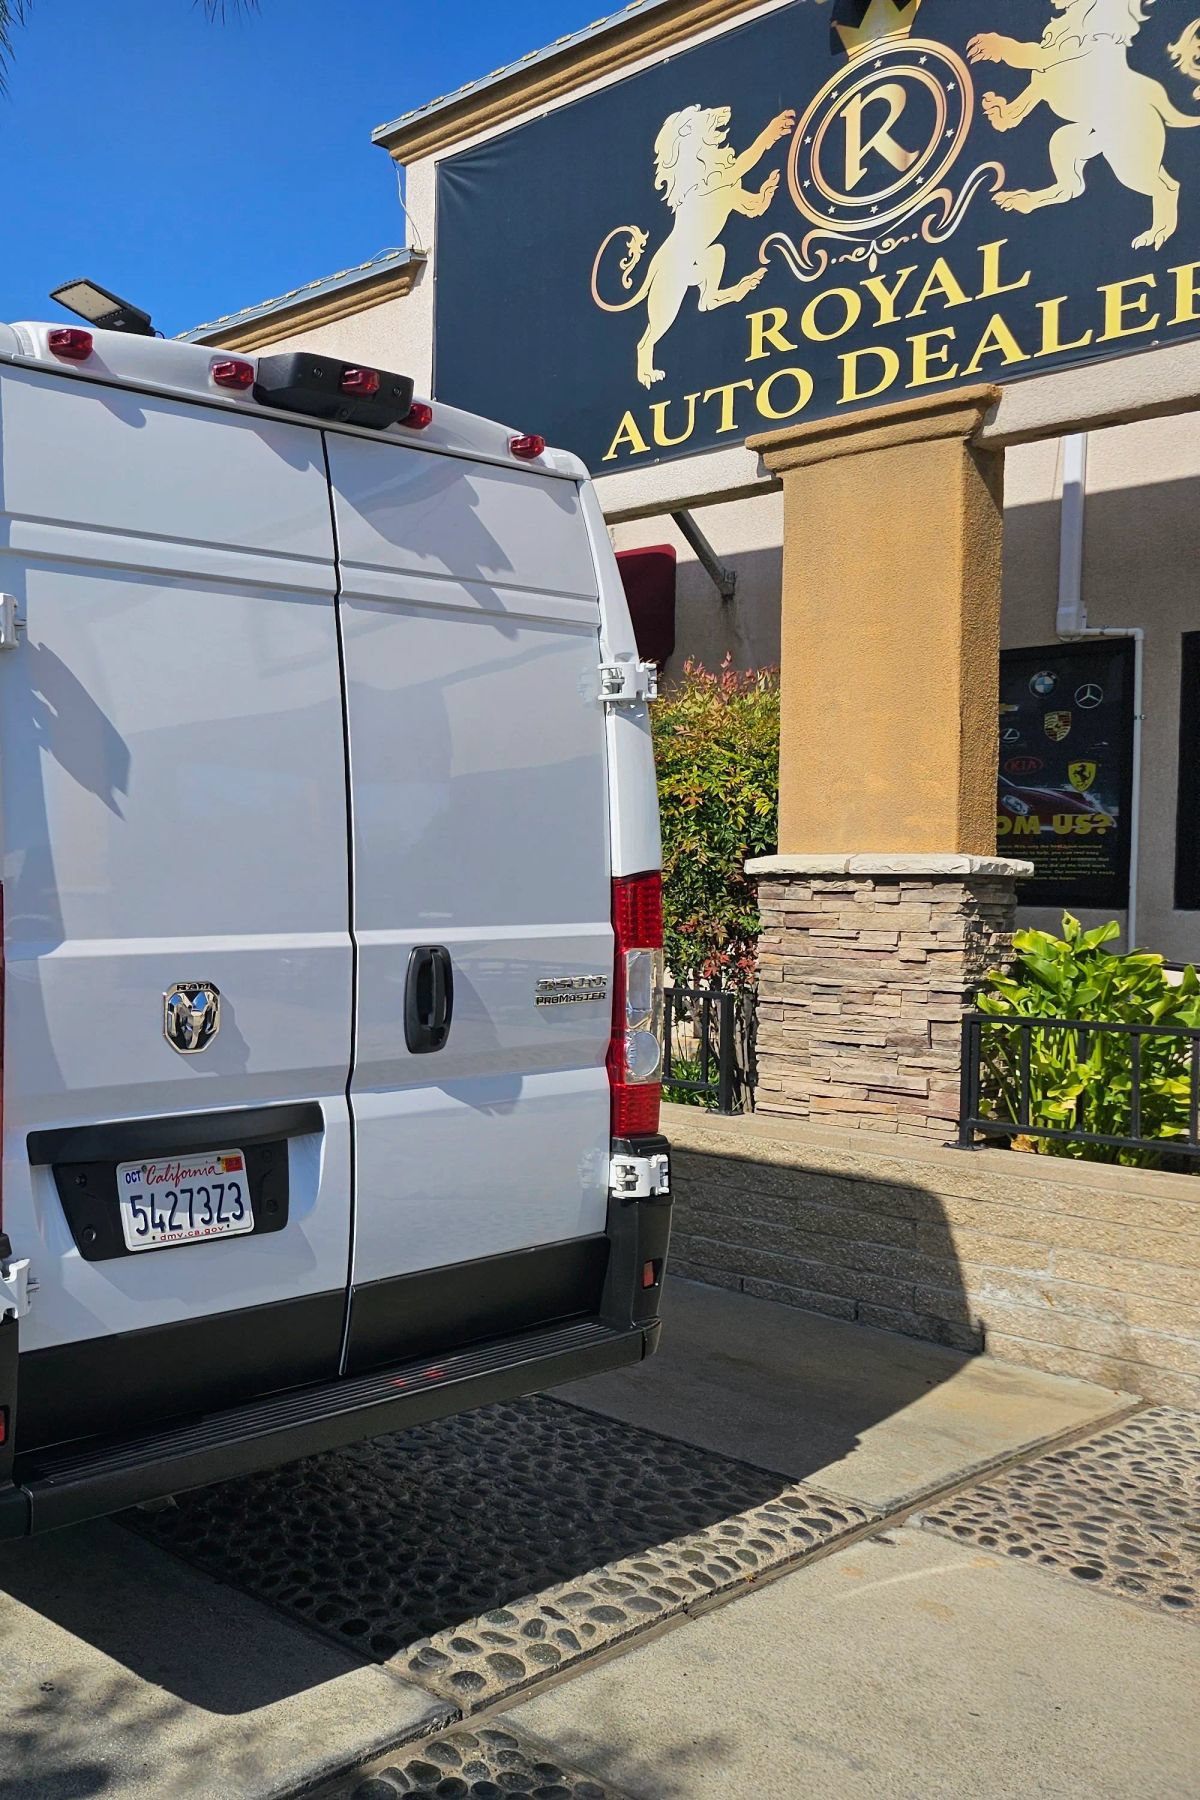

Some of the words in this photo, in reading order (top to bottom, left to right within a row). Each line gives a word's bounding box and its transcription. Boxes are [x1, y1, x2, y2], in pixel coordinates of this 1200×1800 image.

[840, 83, 919, 191] R
[745, 238, 1031, 362] ROYAL
[602, 367, 814, 461] AUTO
[1052, 814, 1111, 835] US?
[176, 983, 210, 991] RAM
[125, 1170, 141, 1184] OCT
[145, 1163, 223, 1188] California
[130, 1182, 244, 1236] 54273Z3
[160, 1225, 225, 1241] dmv.ca.gov
